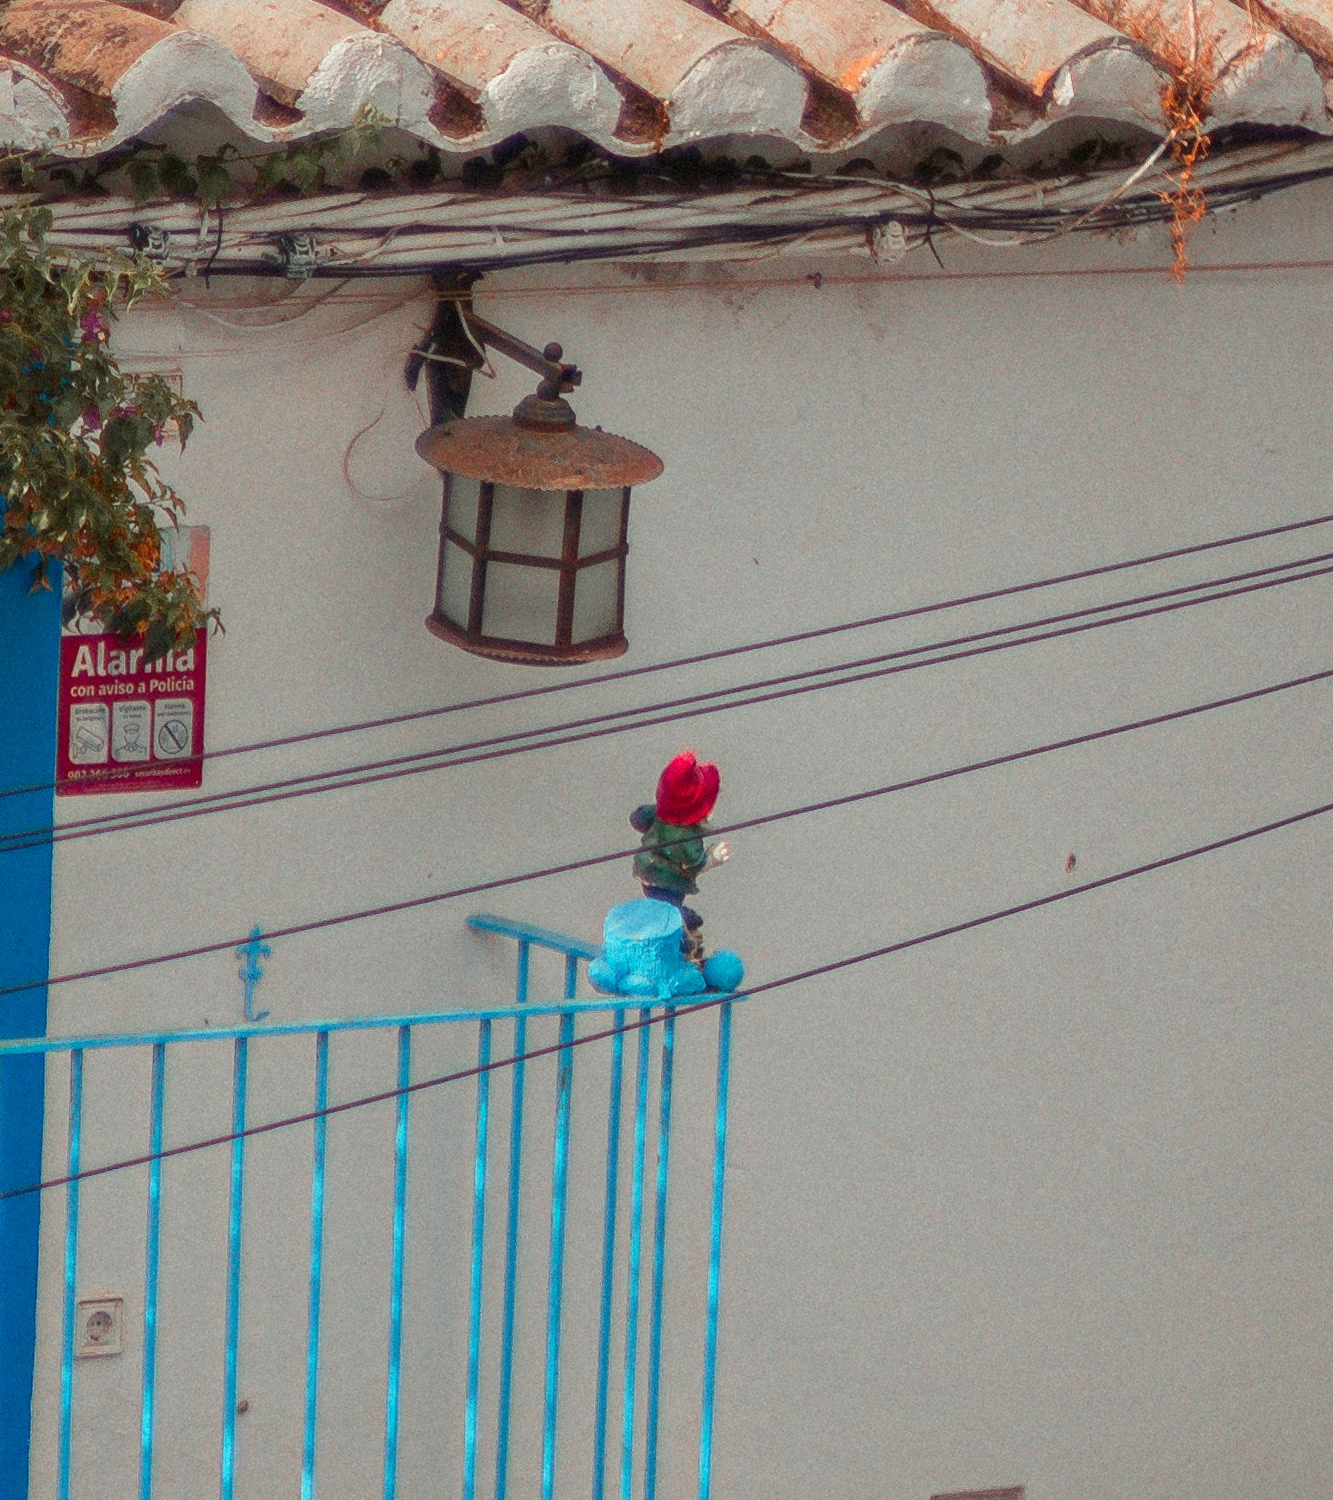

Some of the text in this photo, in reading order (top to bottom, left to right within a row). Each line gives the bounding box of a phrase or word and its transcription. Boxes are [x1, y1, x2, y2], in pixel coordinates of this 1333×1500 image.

[70, 675, 194, 697] con aviso a Policía
